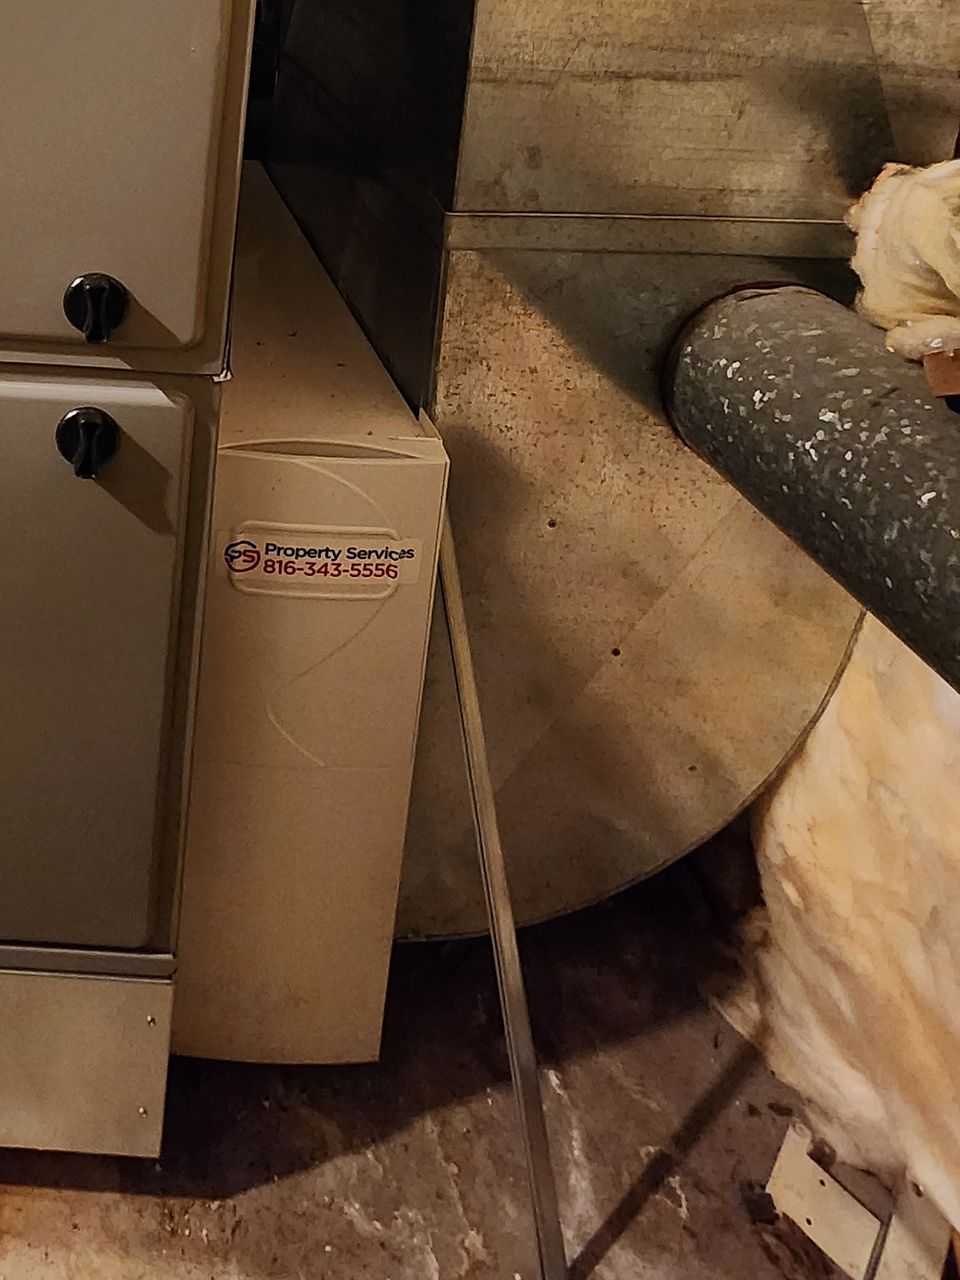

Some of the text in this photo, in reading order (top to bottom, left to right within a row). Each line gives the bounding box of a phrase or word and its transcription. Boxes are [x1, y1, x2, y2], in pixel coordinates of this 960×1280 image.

[265, 542, 415, 562] Property Services
[263, 559, 399, 580] 816-343-5556
